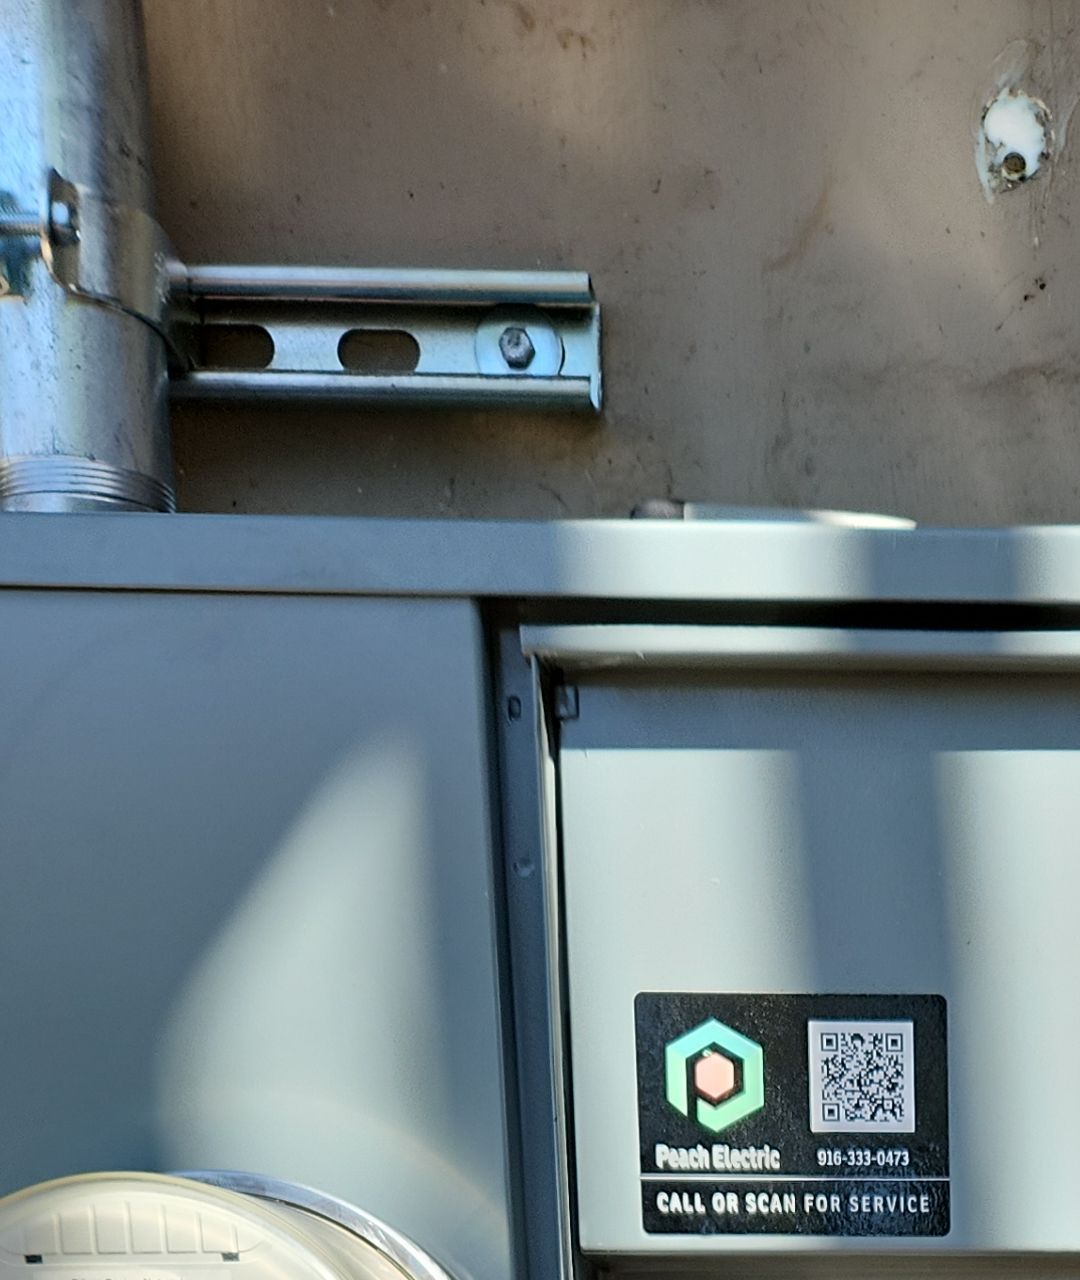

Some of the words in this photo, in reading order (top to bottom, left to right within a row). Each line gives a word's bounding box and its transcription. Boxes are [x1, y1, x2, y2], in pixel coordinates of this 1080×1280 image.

[655, 1144, 709, 1169] Peach
[712, 1145, 781, 1170] Electric
[817, 1150, 910, 1167] 916-333-0473
[656, 1192, 705, 1213] CALL
[712, 1192, 739, 1213] OR
[745, 1193, 796, 1213] SCAN
[803, 1194, 841, 1213] FOR
[850, 1195, 930, 1213] SERVICE
